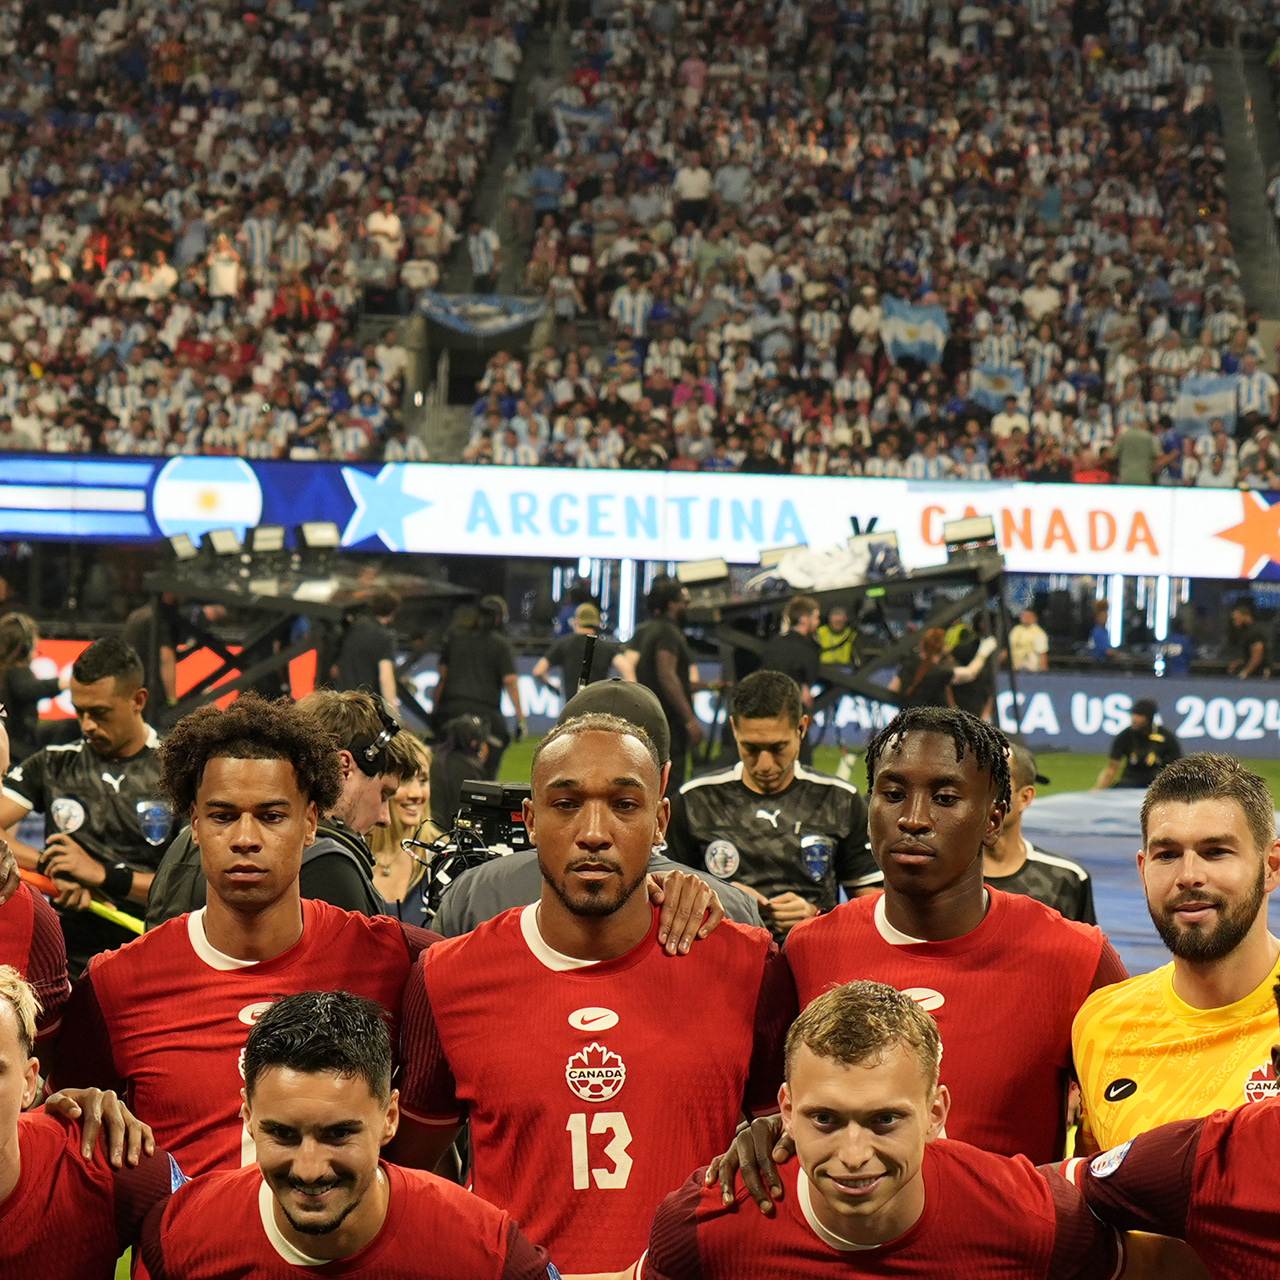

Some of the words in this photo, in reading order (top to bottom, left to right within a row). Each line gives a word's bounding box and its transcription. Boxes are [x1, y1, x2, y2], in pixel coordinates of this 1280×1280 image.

[465, 489, 807, 546] ARGENTINA
[920, 505, 1160, 556] CNADA
[1071, 691, 1163, 737] US
[568, 1069, 624, 1080] CANADA
[566, 1111, 634, 1191] 13
